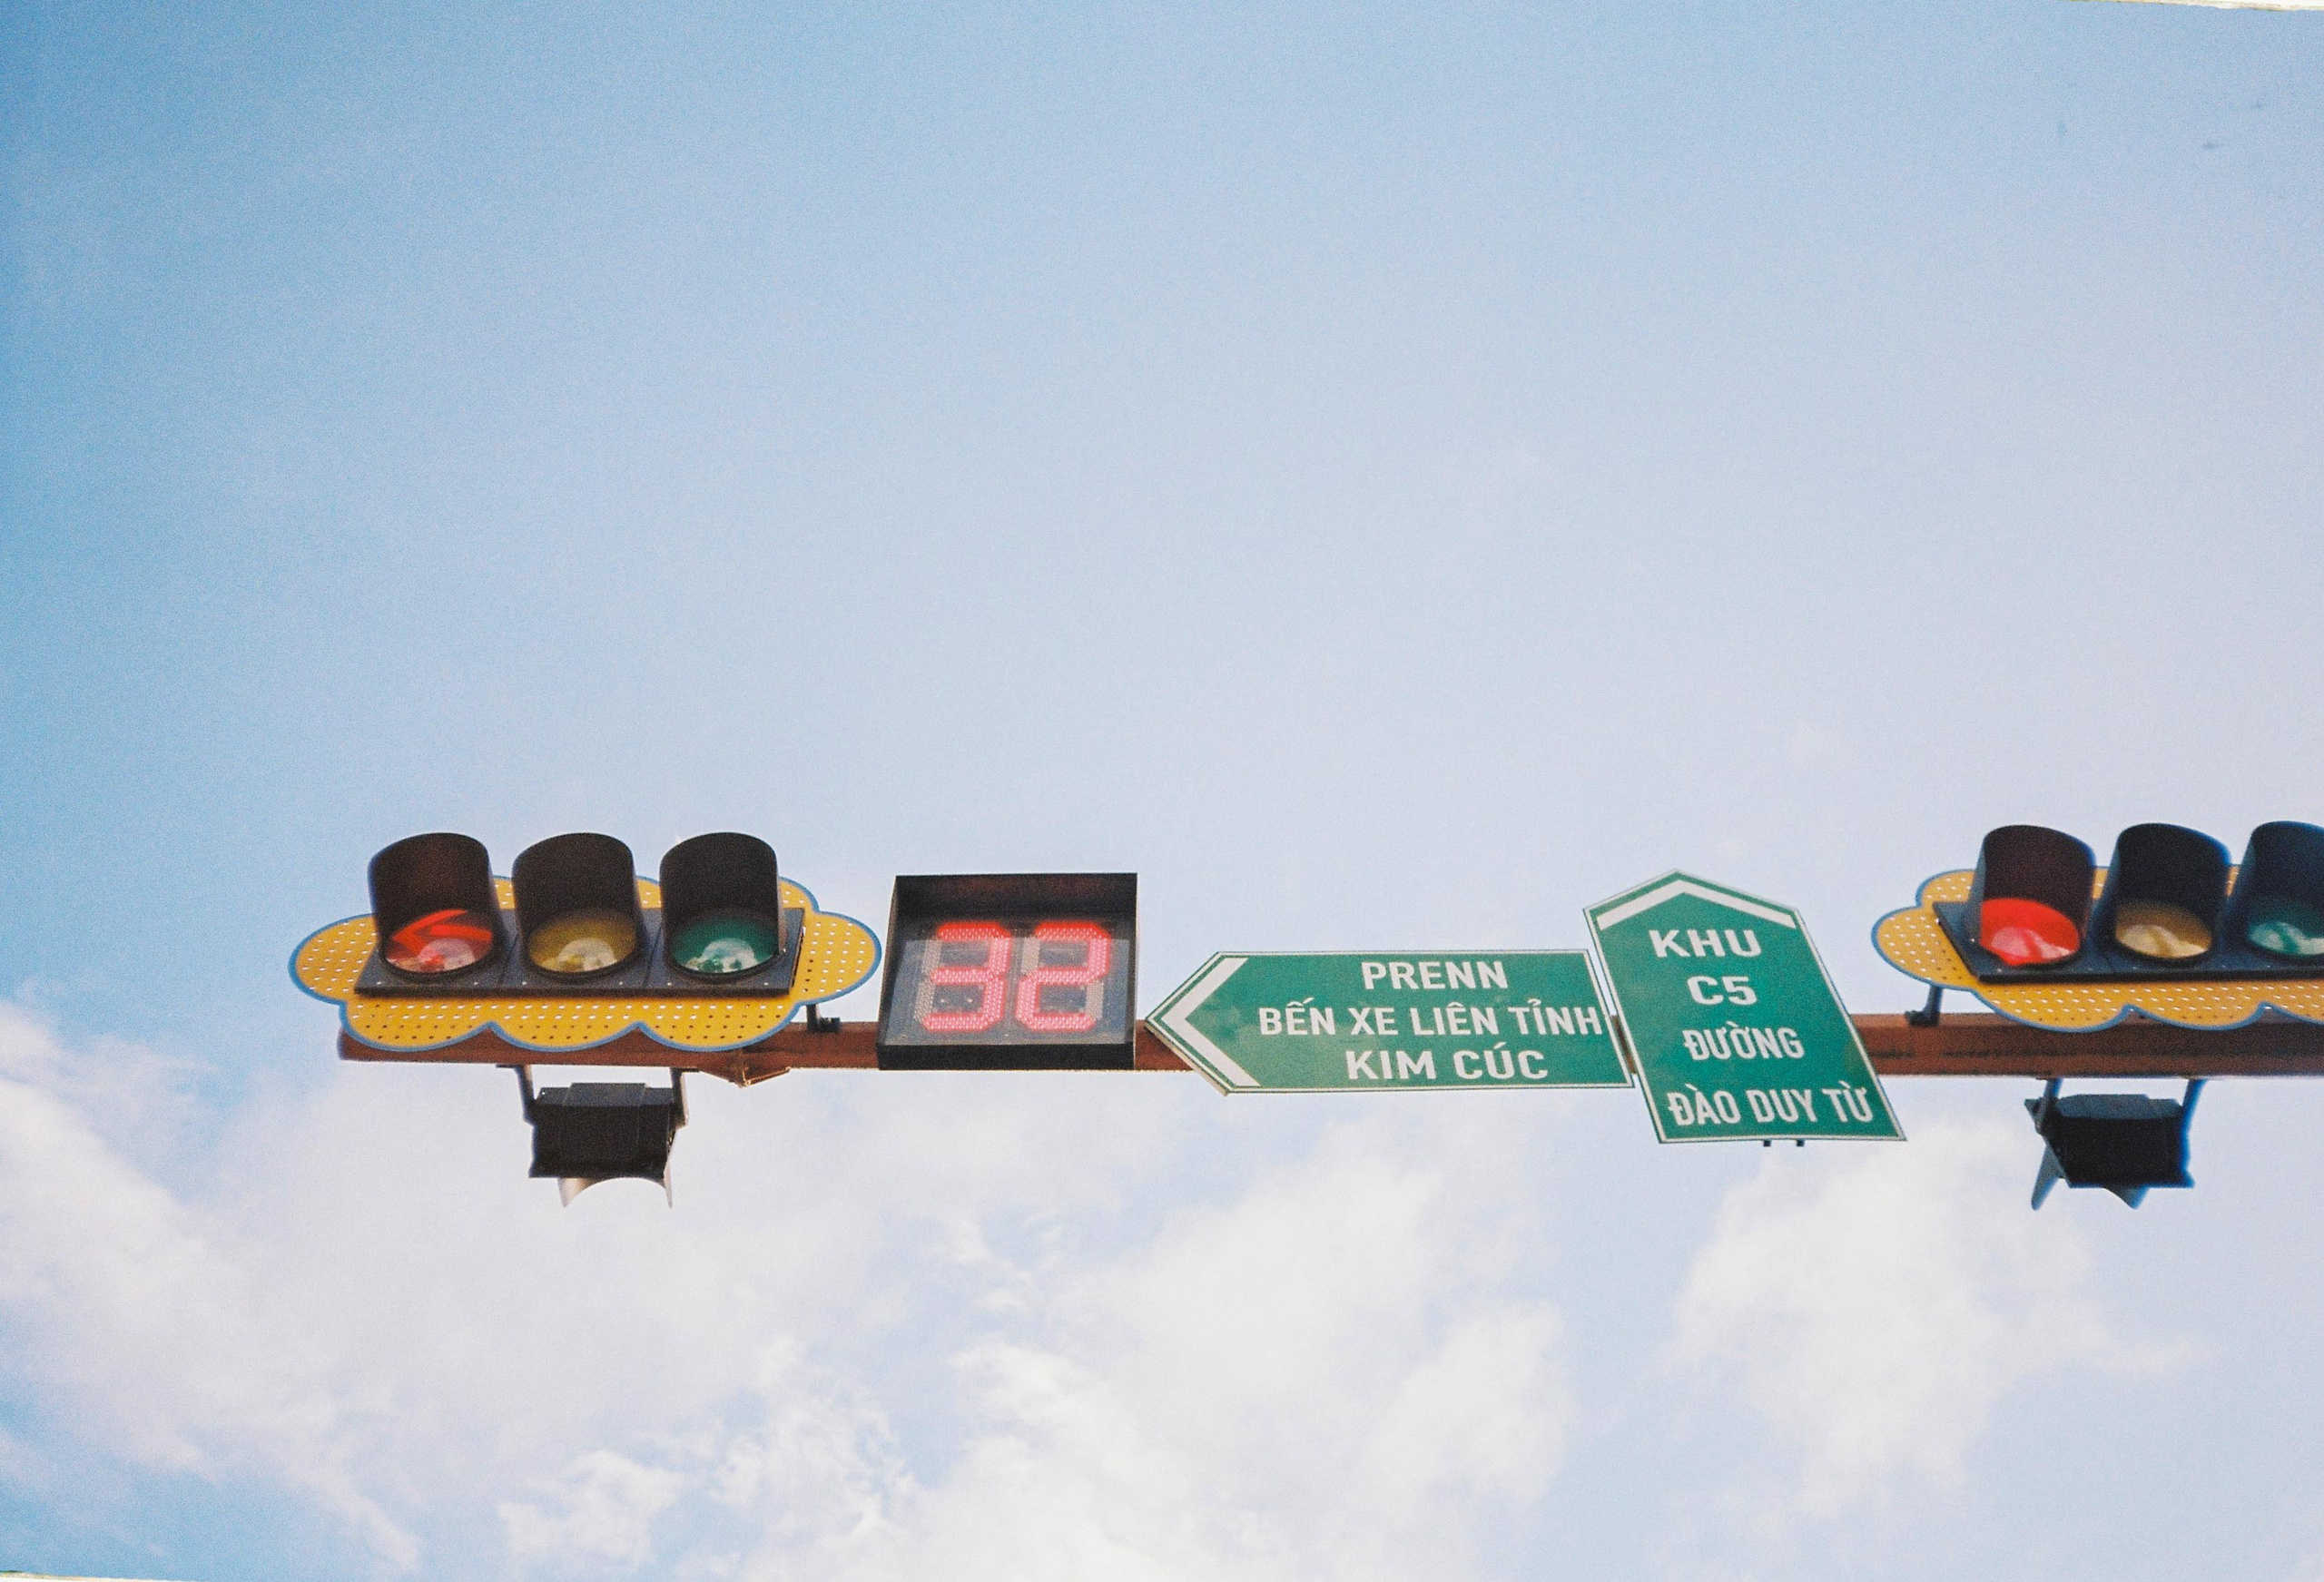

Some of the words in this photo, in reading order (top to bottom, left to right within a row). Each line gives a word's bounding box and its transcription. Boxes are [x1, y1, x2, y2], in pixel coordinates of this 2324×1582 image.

[1649, 929, 1761, 958] KHU
[921, 920, 1111, 1032] 32
[1362, 960, 1508, 990] PRENN
[1687, 976, 1757, 1005] C5
[1258, 997, 1336, 1036] BẾN
[1349, 1006, 1398, 1036] XE
[1410, 1001, 1498, 1036] LIÊN
[1507, 997, 1603, 1036] TỈNH
[1682, 1021, 1805, 1060] ĐƯỜNG
[1346, 1049, 1436, 1080] KIM
[1452, 1042, 1548, 1080] CÚC
[1667, 1084, 1741, 1125] ĐÀO
[1747, 1089, 1817, 1123] DUY
[1821, 1080, 1873, 1123] TỪ
